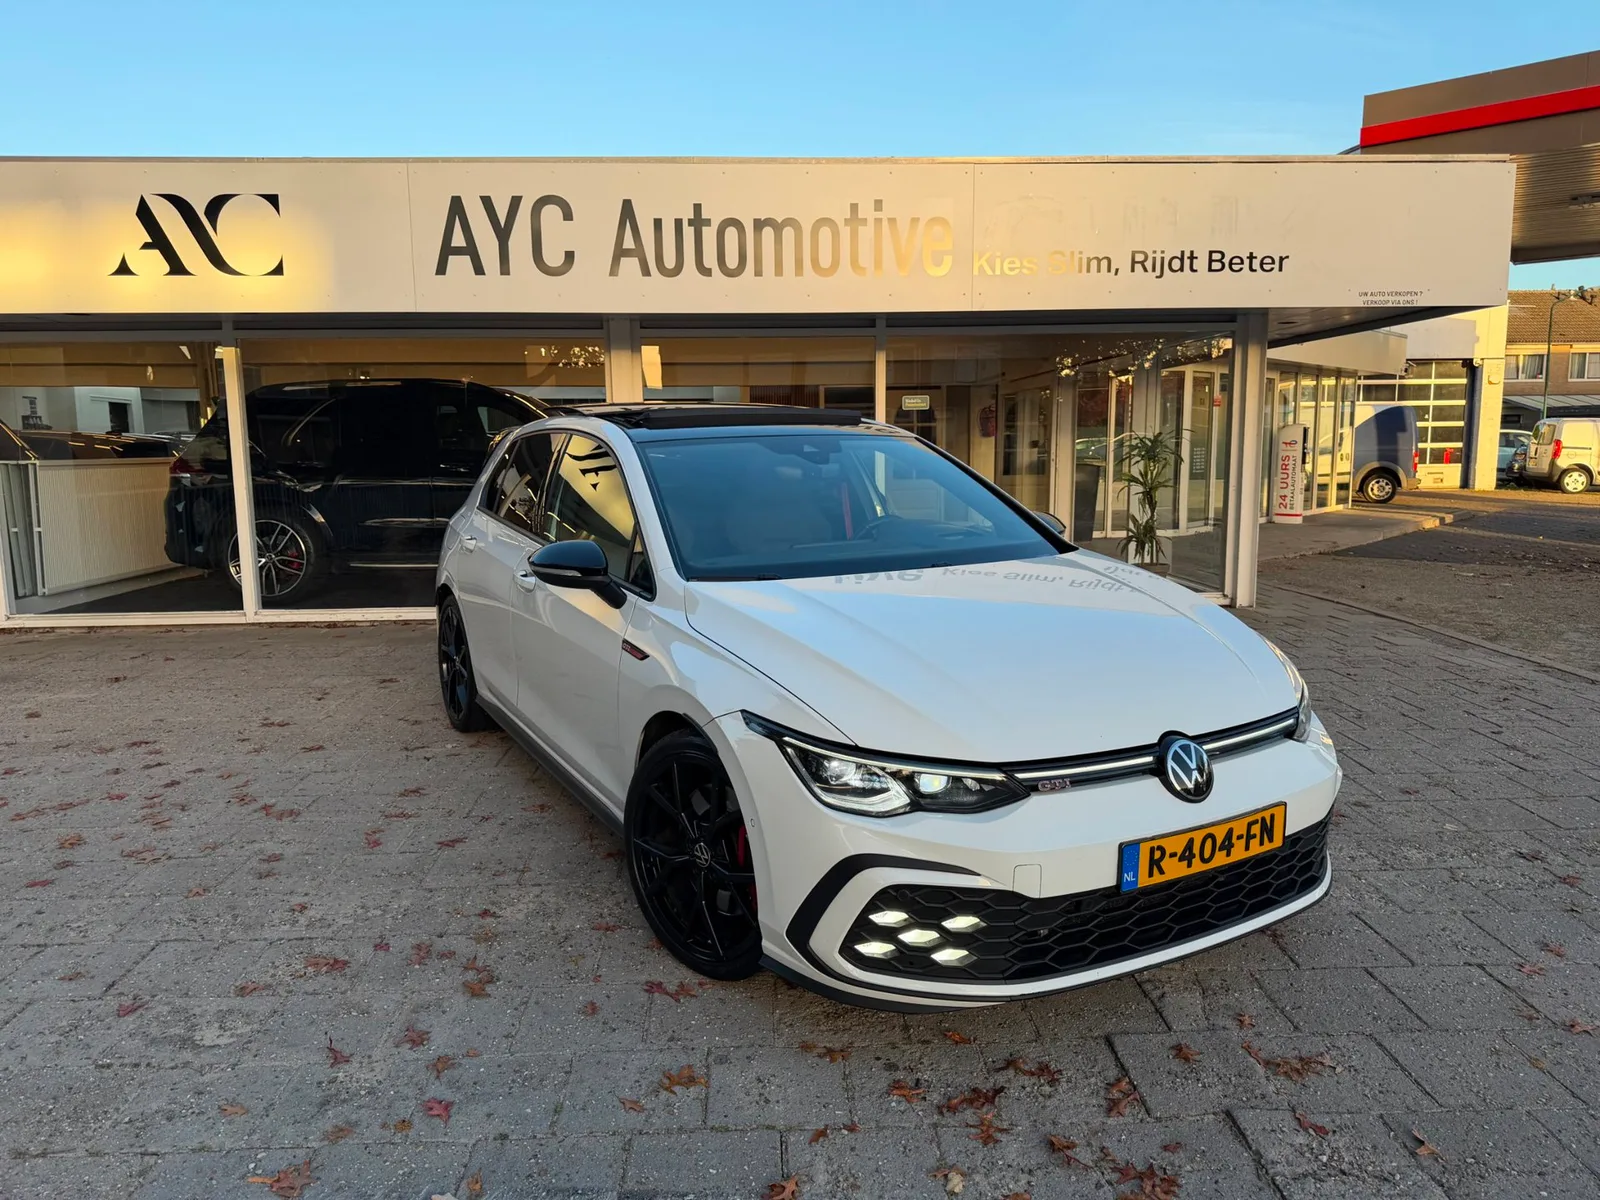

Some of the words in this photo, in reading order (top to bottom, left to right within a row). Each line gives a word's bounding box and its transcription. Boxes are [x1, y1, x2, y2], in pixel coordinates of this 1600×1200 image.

[434, 194, 576, 277] AYC
[608, 198, 954, 277] Automotive
[973, 250, 1038, 276] Kies
[1048, 249, 1120, 277] Slim,
[1130, 249, 1199, 280] Rijdt
[1207, 249, 1290, 274] Beter
[1387, 290, 1418, 298] VERKOPEN
[1280, 454, 1291, 490] UURS
[1278, 494, 1288, 510] 24
[1037, 778, 1071, 792] GTI
[1147, 813, 1276, 879] R-404-FN
[1123, 872, 1136, 882] NL
